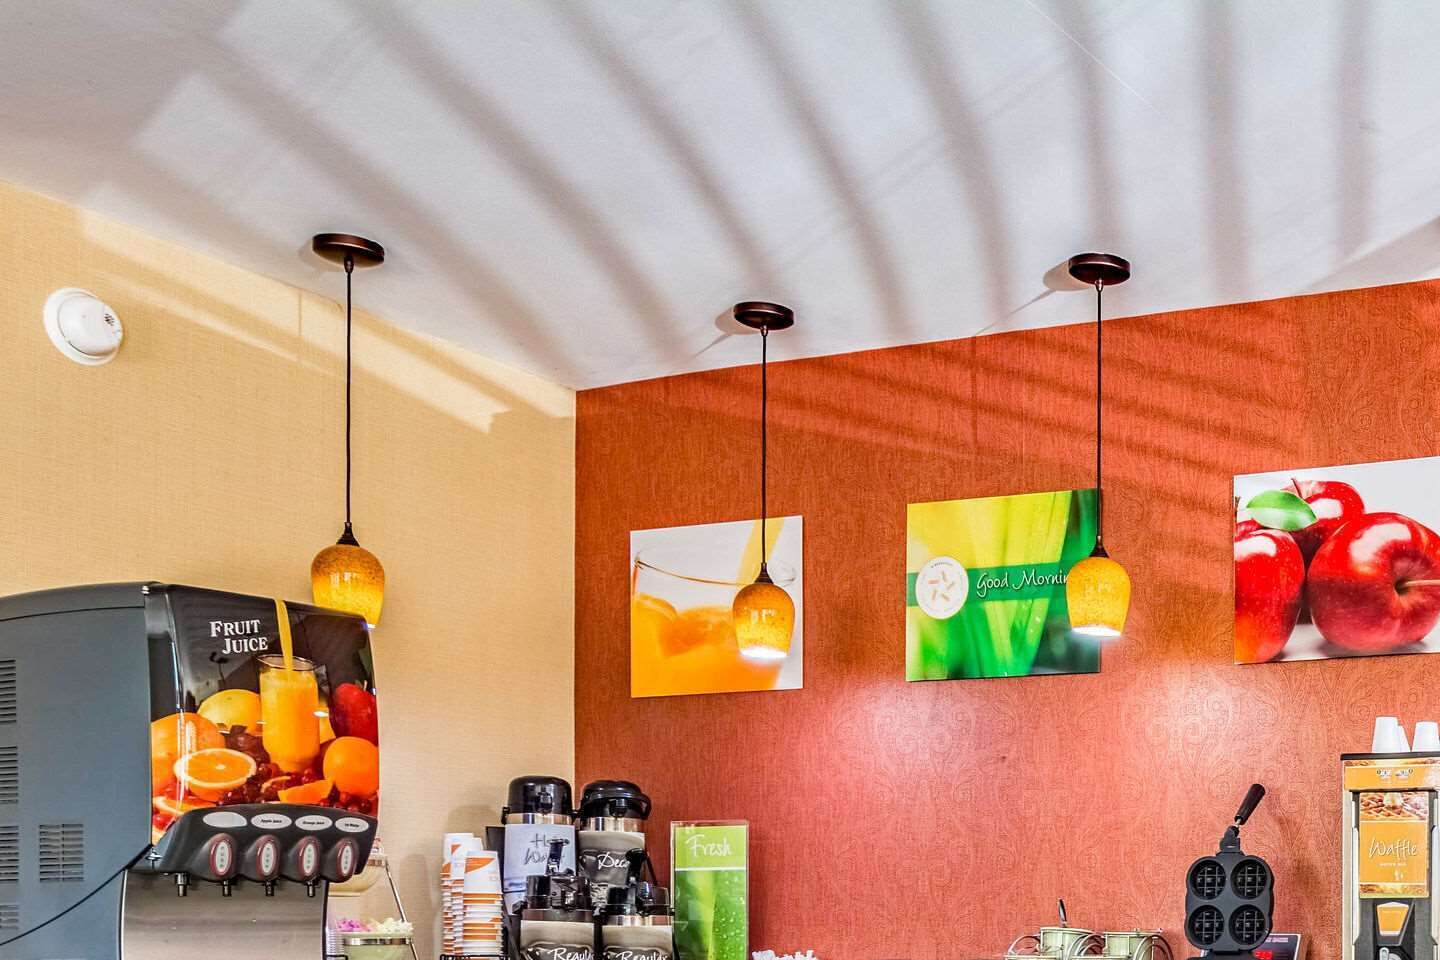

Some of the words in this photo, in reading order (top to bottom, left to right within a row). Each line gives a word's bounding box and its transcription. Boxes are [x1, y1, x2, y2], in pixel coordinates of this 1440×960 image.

[976, 571, 1009, 598] Good
[1012, 568, 1069, 590] Mornin
[209, 619, 261, 638] FRUIT
[222, 637, 269, 654] JUICE
[685, 833, 732, 858] Fresh
[1368, 837, 1418, 860] Waffle
[597, 851, 631, 870] Deca
